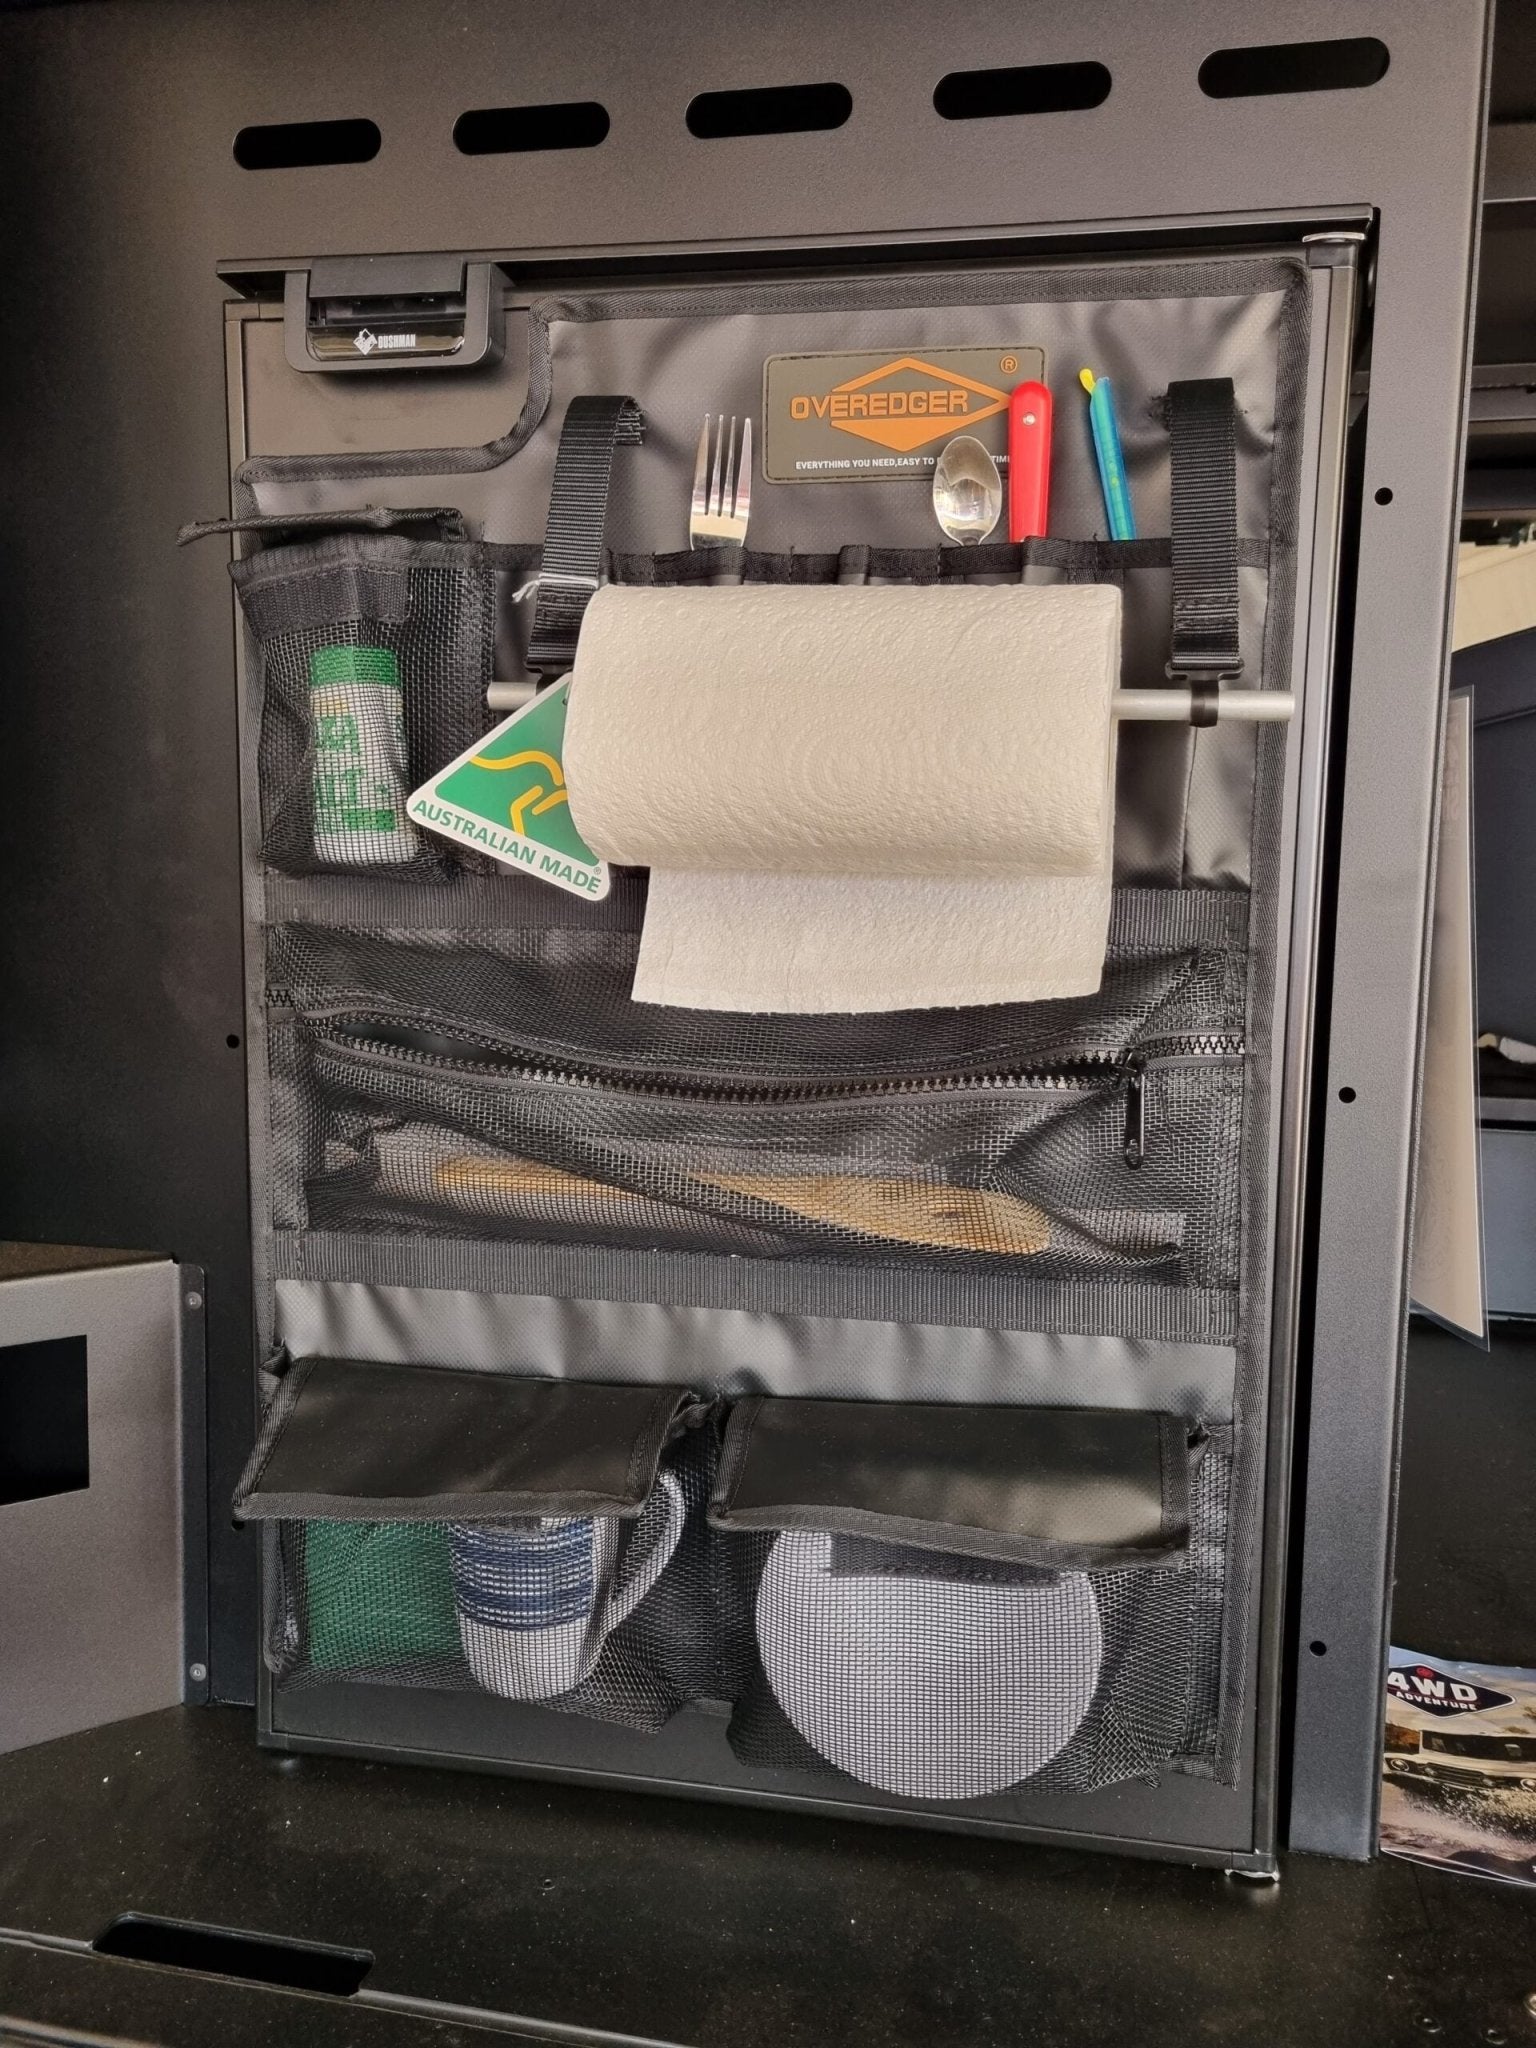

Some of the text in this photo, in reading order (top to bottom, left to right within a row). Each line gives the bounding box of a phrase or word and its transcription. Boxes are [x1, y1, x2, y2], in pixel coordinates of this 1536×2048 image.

[377, 334, 416, 349] BUSHMAN
[790, 390, 969, 420] OVEREDGER
[795, 459, 850, 470] EVERYTHING
[852, 458, 870, 468] YOU
[922, 456, 935, 466] TO
[989, 455, 1010, 464] TIM
[412, 799, 602, 894] AUSTRALIAN MADE
[1388, 1671, 1478, 1702] 4WD
[1395, 1691, 1478, 1711] ADVENTURE
